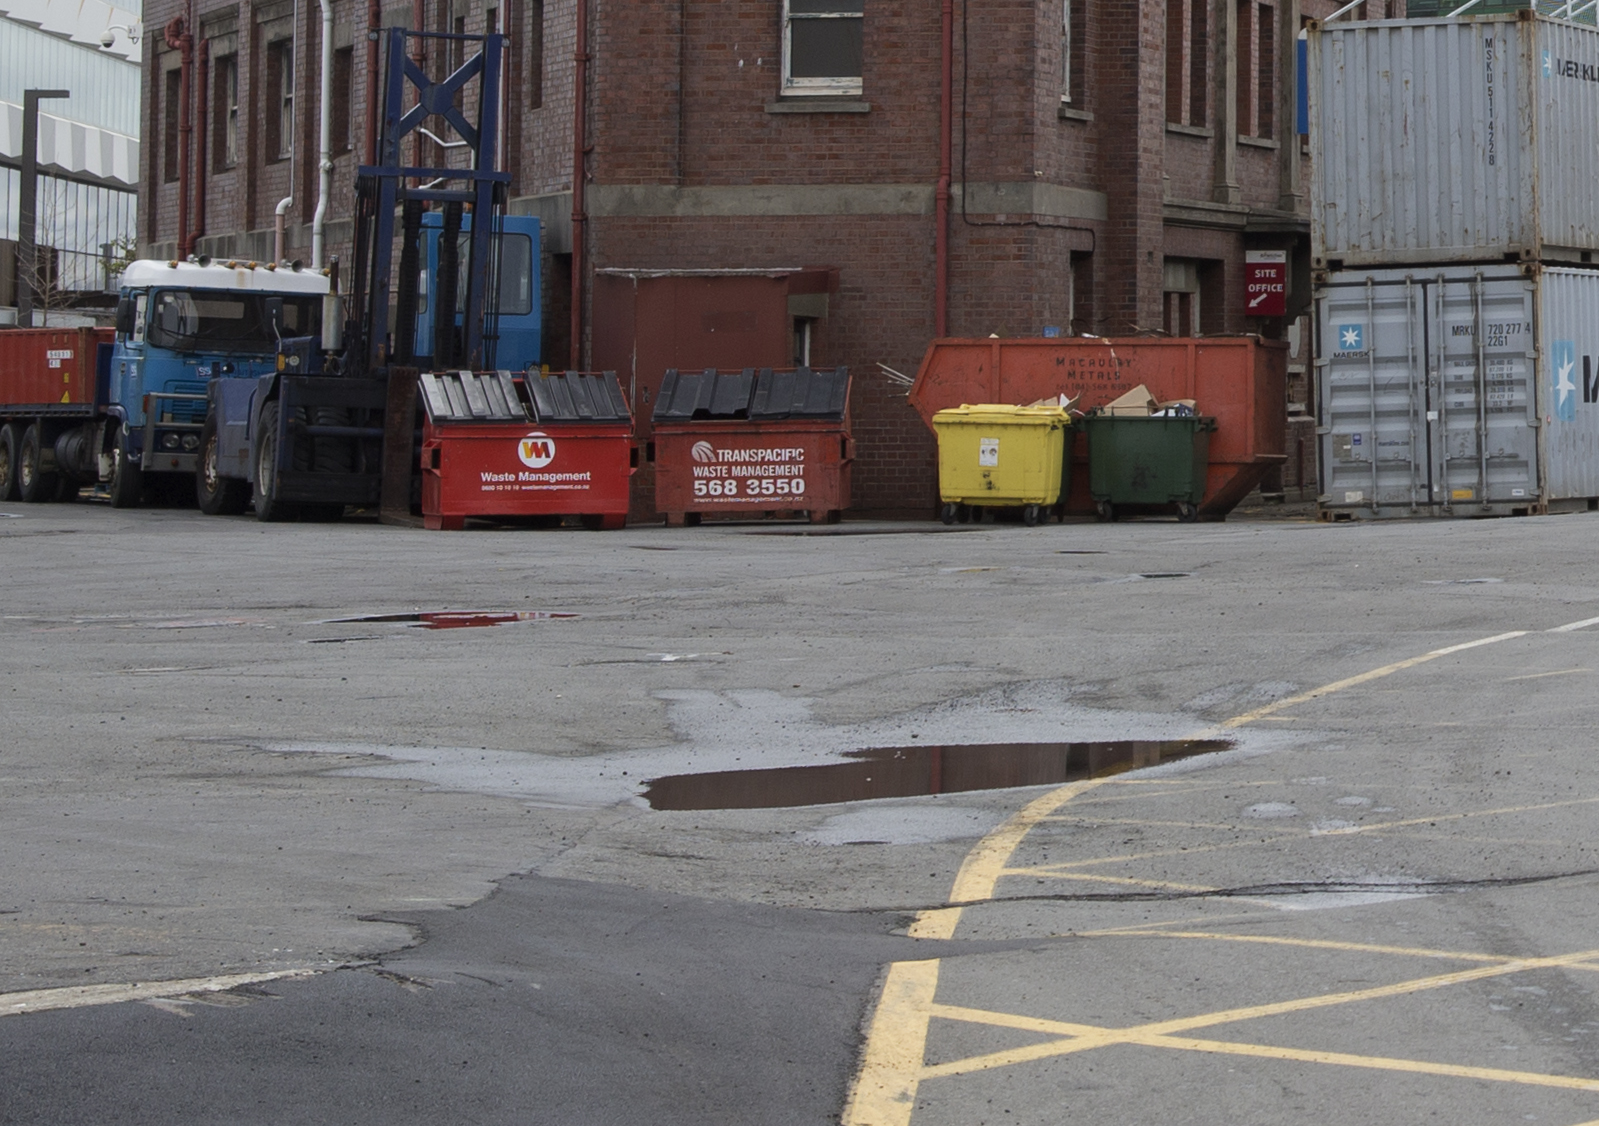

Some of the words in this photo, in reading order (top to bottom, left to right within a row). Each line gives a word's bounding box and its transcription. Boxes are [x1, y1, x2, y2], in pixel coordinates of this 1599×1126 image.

[1485, 38, 1493, 83] MSKU
[1255, 269, 1277, 278] SITE
[1248, 284, 1284, 292] OFFICE
[1452, 325, 1477, 337] MRKU
[1488, 324, 1503, 335] 720
[1505, 324, 1521, 334] 277
[1487, 336, 1508, 347] 22G1
[1333, 351, 1370, 359] MAERSK
[1067, 370, 1121, 381] METALS
[717, 449, 804, 462] TRANSPACIFIC
[693, 465, 728, 477] WASTE
[732, 464, 805, 476] MANAGEMENT
[481, 472, 516, 481] Waste
[519, 471, 591, 483] Management
[694, 479, 738, 495] 568
[746, 478, 805, 495] 3550
